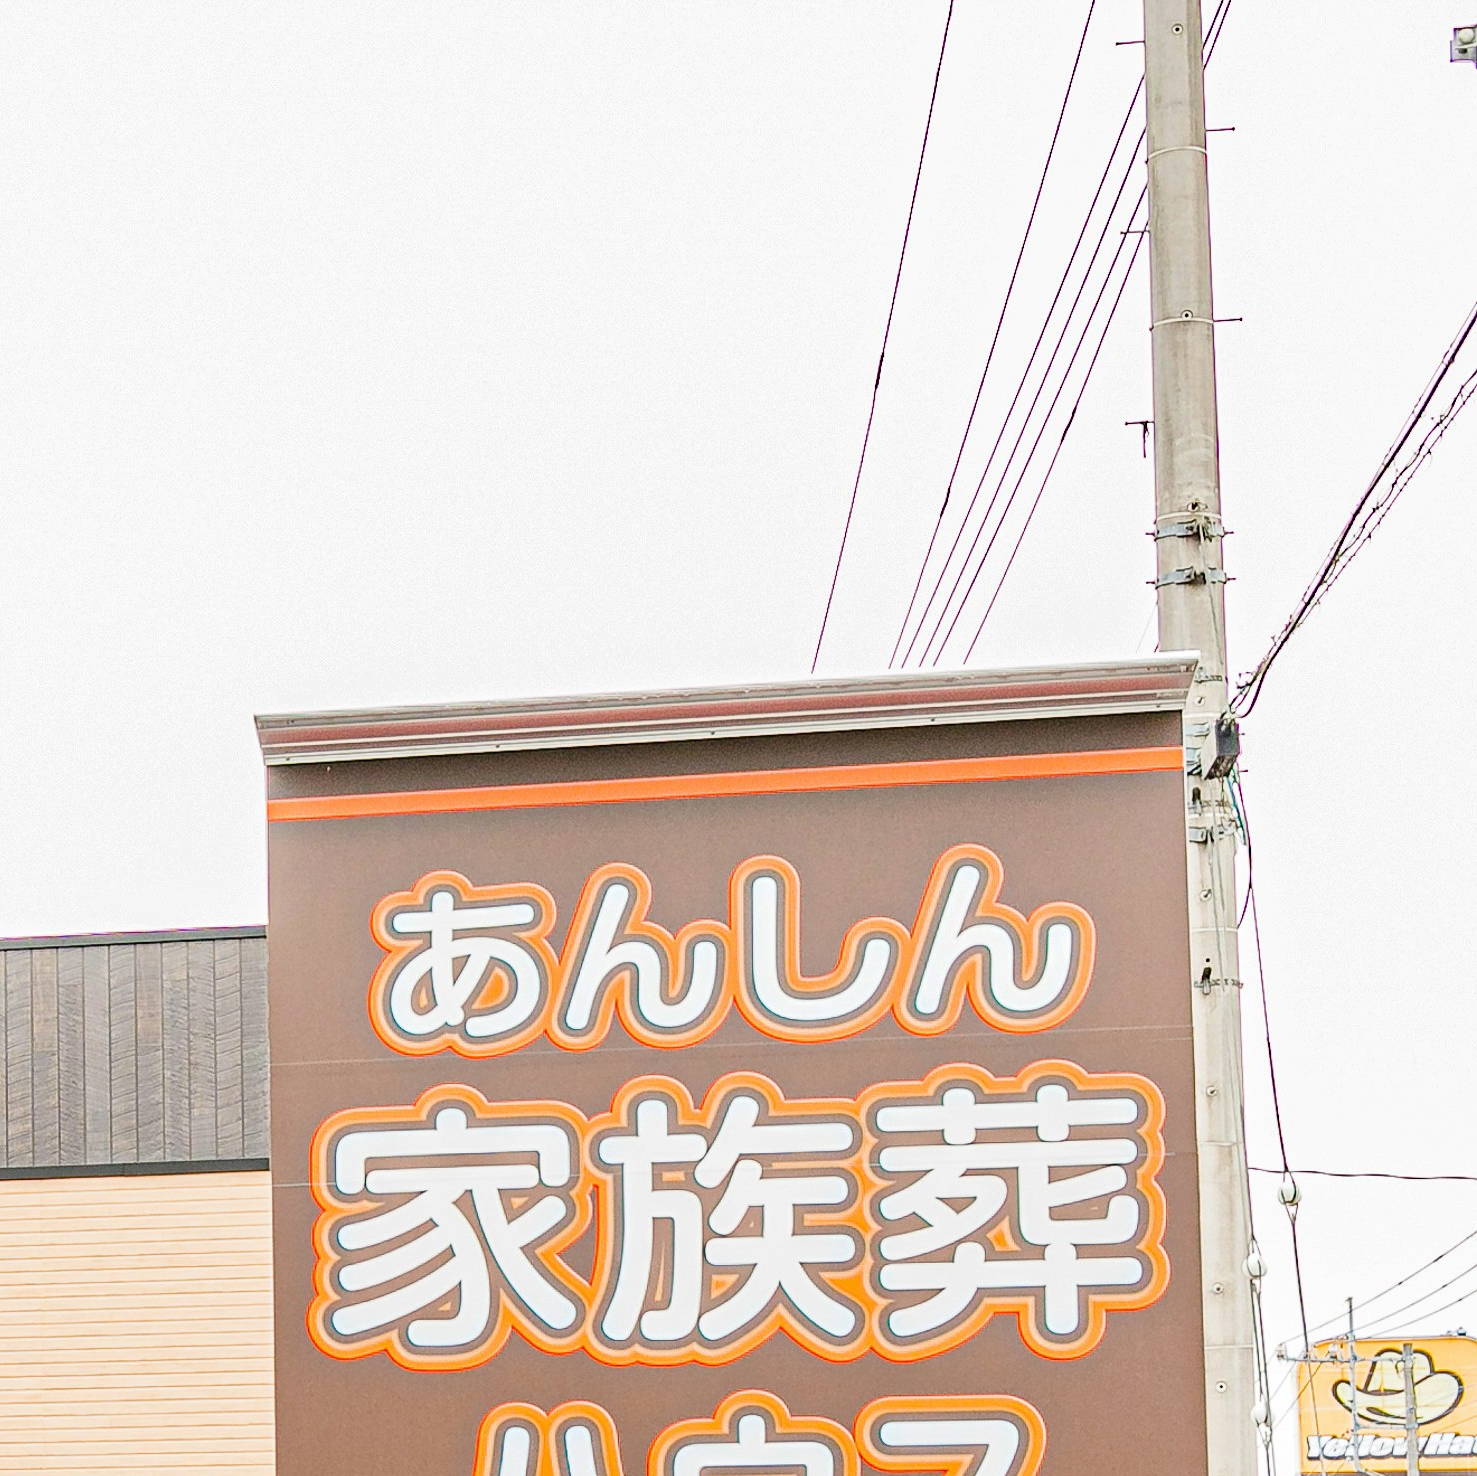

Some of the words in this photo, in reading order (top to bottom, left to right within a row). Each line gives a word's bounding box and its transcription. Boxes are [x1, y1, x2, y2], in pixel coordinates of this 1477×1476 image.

[379, 853, 1085, 1048] あんしん
[319, 1071, 1157, 1358] 家族葬
